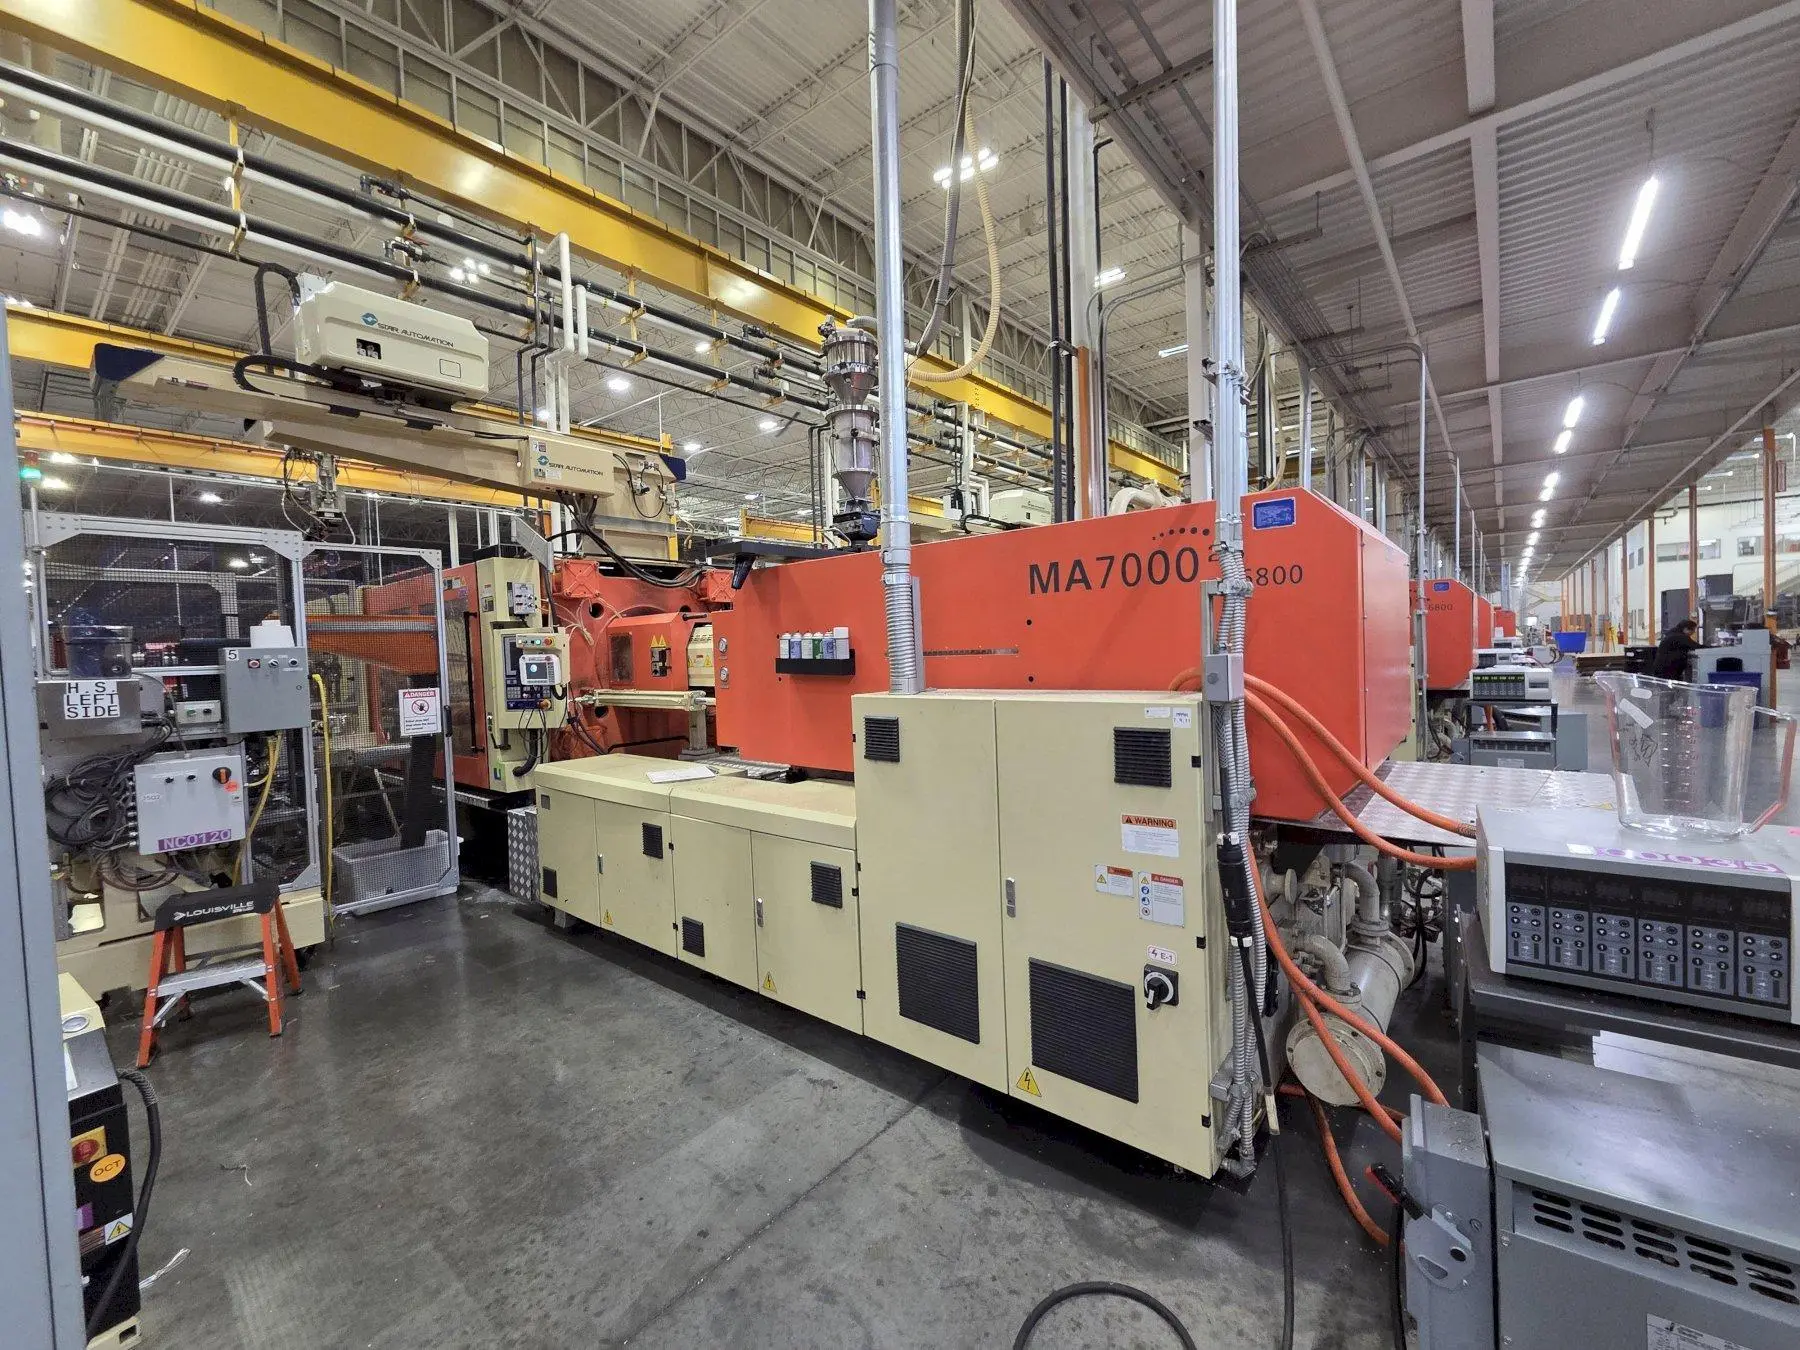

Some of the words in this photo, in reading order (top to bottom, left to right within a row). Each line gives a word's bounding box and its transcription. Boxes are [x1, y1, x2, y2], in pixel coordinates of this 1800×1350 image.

[377, 322, 399, 334] STAR
[401, 329, 454, 348] AUTOMATION
[1028, 546, 1200, 595] MA7000
[228, 649, 237, 660] 5
[66, 693, 119, 706] LEFT
[410, 690, 435, 698] DANGER
[66, 704, 119, 718] SIDE
[1135, 816, 1174, 828] WARNING
[186, 900, 254, 917] LOUISVILLE
[93, 1159, 121, 1177] OCT
